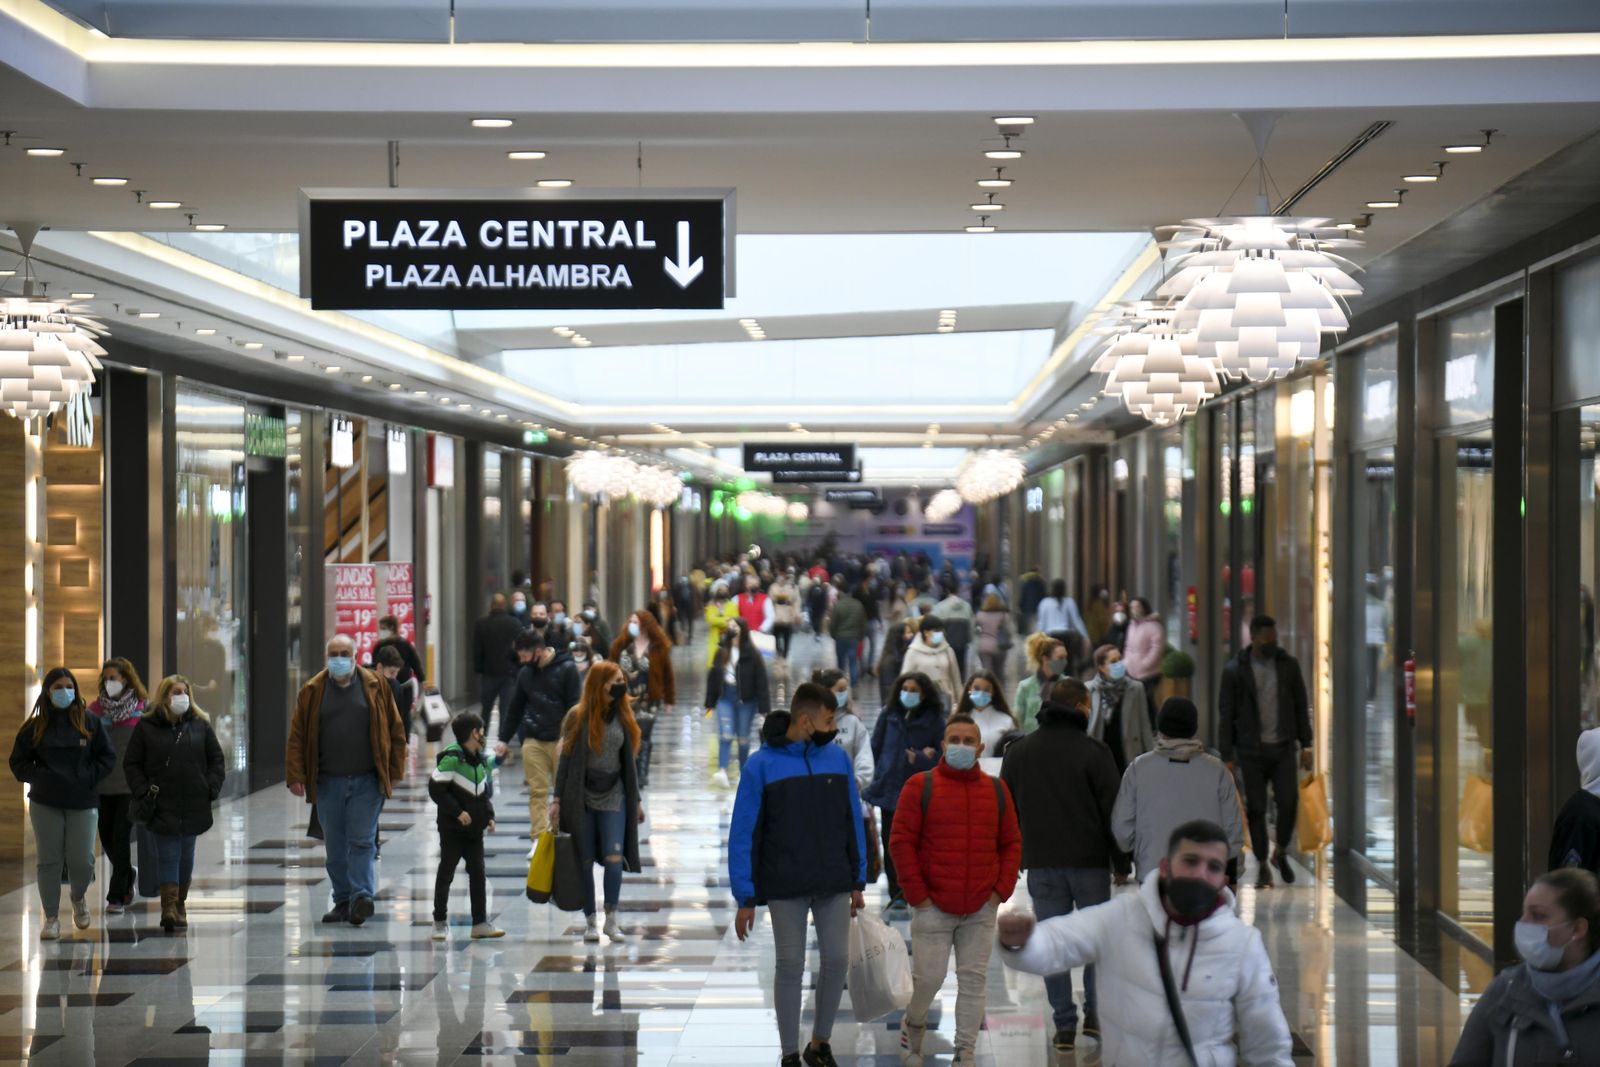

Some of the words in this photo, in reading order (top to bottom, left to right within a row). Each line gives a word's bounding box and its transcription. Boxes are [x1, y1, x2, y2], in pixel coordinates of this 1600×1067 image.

[343, 219, 467, 248] PLAZA
[479, 219, 656, 248] CENTRAL
[365, 264, 462, 288] PLAZA
[466, 264, 632, 288] ALHAMBRA
[753, 452, 790, 464] PLAZA
[792, 452, 843, 464] CENTRAL
